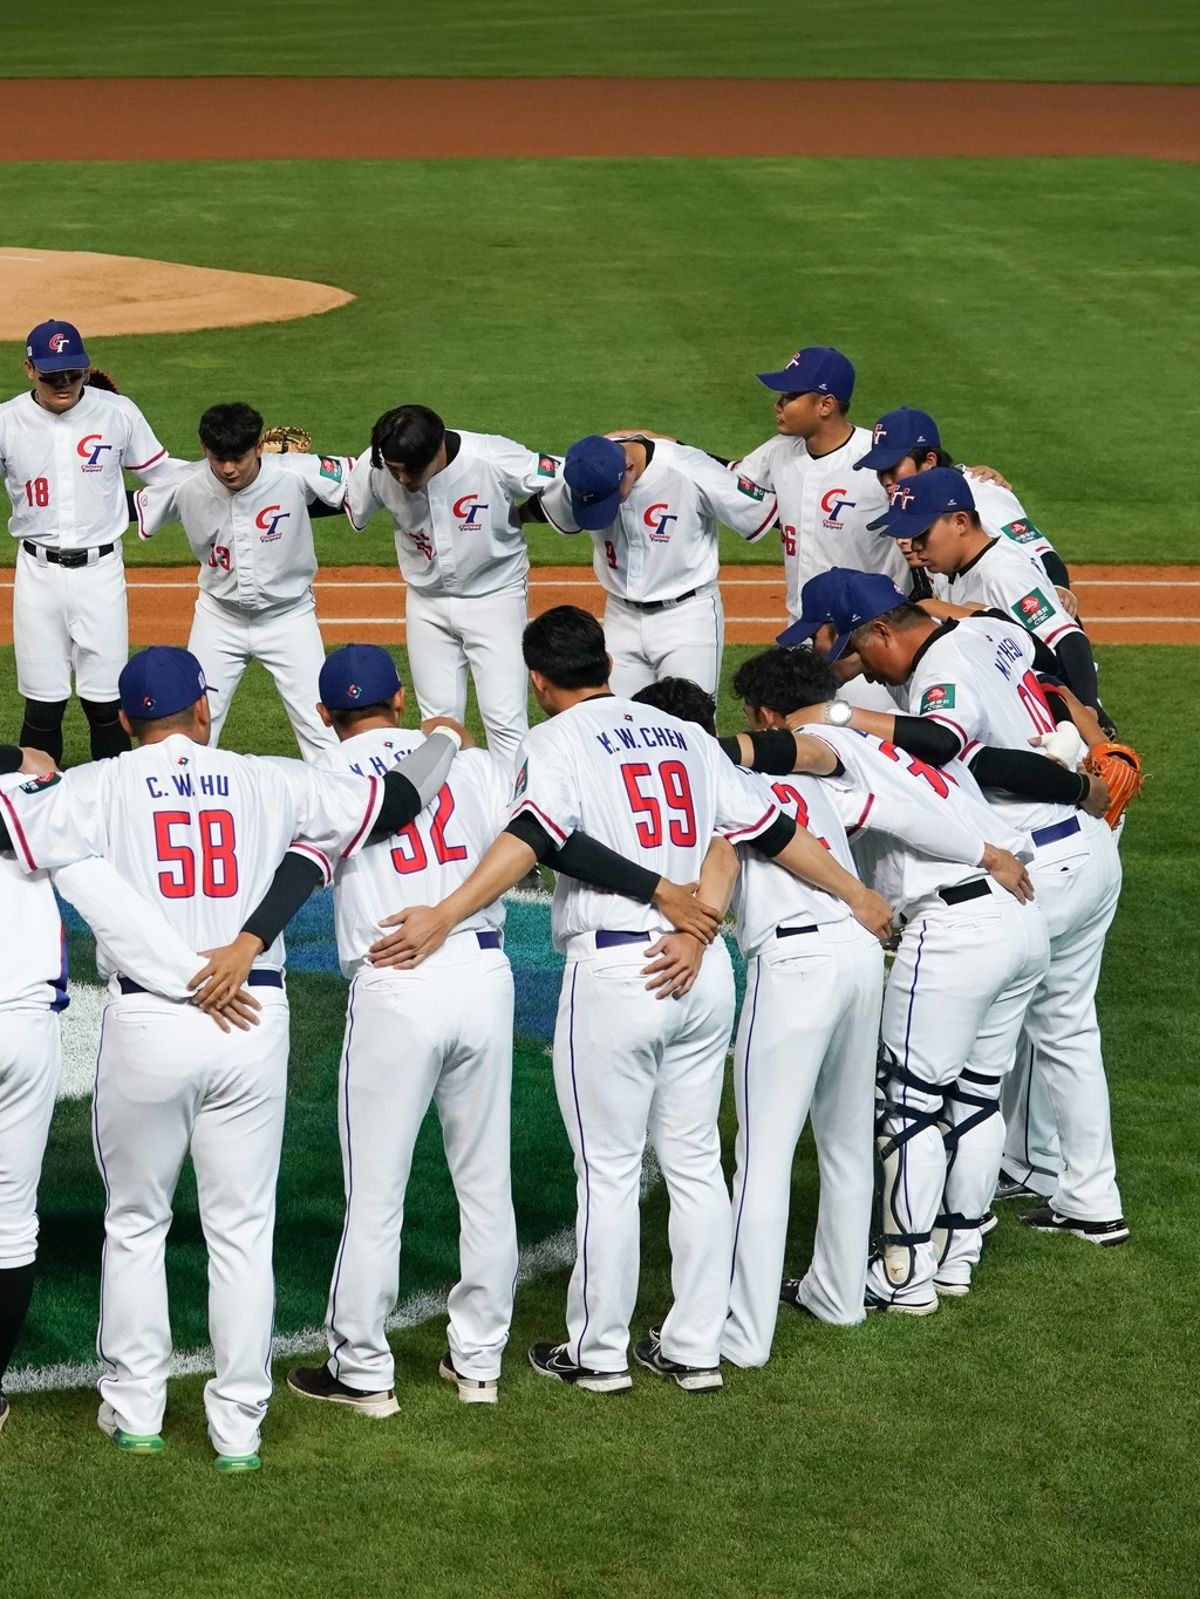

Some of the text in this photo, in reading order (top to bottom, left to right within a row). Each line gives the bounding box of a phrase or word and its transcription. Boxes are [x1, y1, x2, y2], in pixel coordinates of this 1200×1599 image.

[25, 477, 49, 507] 18
[620, 760, 697, 849] 59
[152, 809, 238, 899] 58
